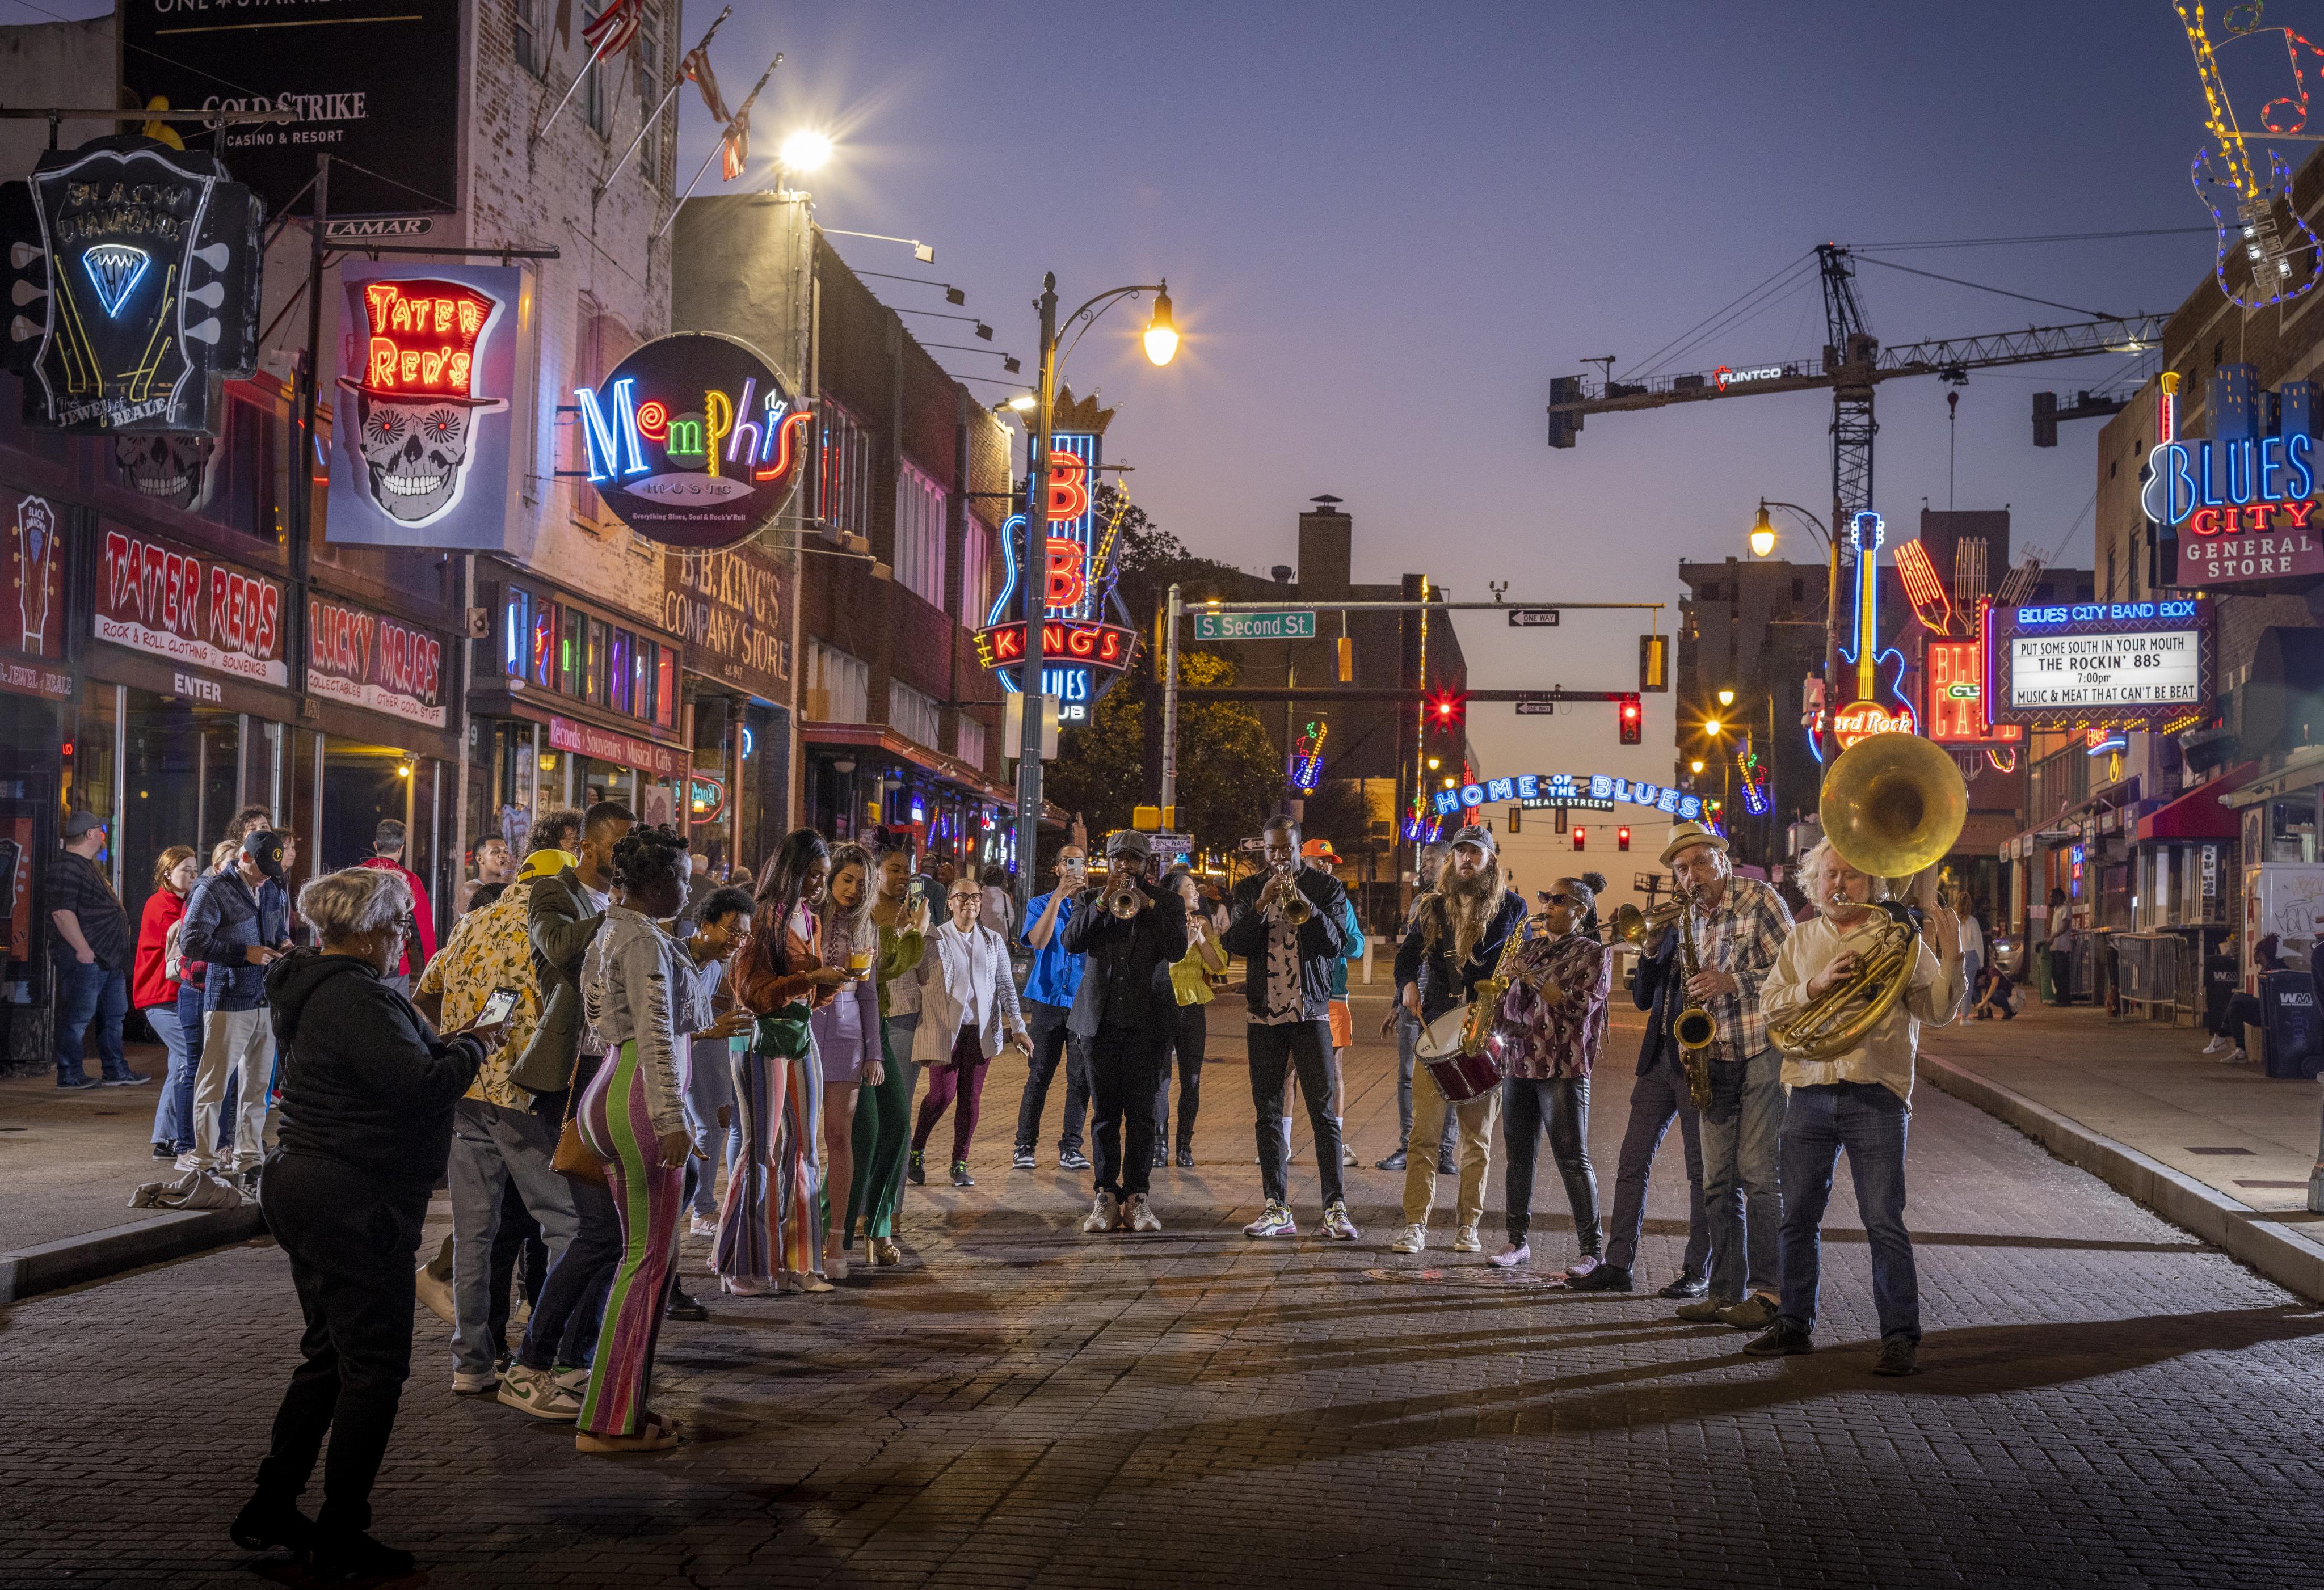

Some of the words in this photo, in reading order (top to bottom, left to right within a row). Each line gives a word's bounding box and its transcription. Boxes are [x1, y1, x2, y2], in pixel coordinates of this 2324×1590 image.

[202, 95, 271, 129] GOLD
[277, 91, 367, 125] STRIKE
[227, 133, 274, 146] CASINO
[279, 133, 287, 144] &
[292, 130, 344, 144] RESORT
[325, 220, 421, 236] LAMAR
[368, 285, 477, 333] TATER
[370, 337, 470, 387] RED'S
[1719, 368, 1781, 383] FLINTCO
[111, 397, 167, 427] BEALE
[574, 376, 812, 483] Memphis
[2167, 432, 2314, 525] BLUES
[26, 517, 47, 534] DIAMOND
[27, 505, 45, 521] BLACK
[633, 513, 667, 521] Everything
[668, 513, 687, 521] Blues,
[689, 513, 702, 521] Soul
[2190, 501, 2315, 536] CITY
[2187, 536, 2313, 560] GENERAL
[2208, 556, 2292, 577] STORE
[106, 530, 201, 637] TATER
[210, 565, 279, 659] RED'S
[2018, 607, 2068, 623] BLUES
[2072, 605, 2106, 621] CITY
[2111, 604, 2153, 618] BAND
[2159, 601, 2195, 617] BOX
[665, 589, 739, 658] COMPANY
[742, 622, 788, 682] STORE
[1202, 617, 1218, 636] S.
[1222, 616, 1281, 636] Second
[1285, 615, 1308, 634] St.
[103, 622, 129, 639] ROCK
[133, 628, 140, 643] &
[142, 632, 165, 650] ROLL
[168, 636, 208, 661] CLOTHING
[222, 655, 266, 678] SOUVENIRS
[311, 601, 374, 681] LUCKY
[379, 622, 440, 705] MOJOS
[993, 626, 1119, 660] KNG'S
[2021, 644, 2037, 655] PUT
[2041, 642, 2065, 655] SOME
[2069, 640, 2098, 653] SOUTH
[2102, 639, 2112, 652] IN
[2117, 638, 2146, 651] YOUR
[2150, 636, 2184, 651] MOUTH
[1935, 647, 1980, 685] BLU
[2039, 657, 2062, 671] THE
[2070, 655, 2127, 670] ROCKIN'
[2134, 654, 2161, 668] 88S
[7, 665, 39, 689] JEWEL
[45, 673, 73, 695] BEALE
[174, 674, 221, 703] ENTER
[308, 674, 361, 698] COLLECTABLES
[376, 694, 399, 708] OTHER
[401, 698, 418, 714] COOL
[420, 707, 440, 721] STUFF
[2018, 690, 2047, 703] MUSIC
[2051, 689, 2058, 702] &
[2062, 689, 2087, 702] MEAT
[2092, 687, 2117, 701] THAT
[2121, 686, 2150, 700] CAN'T
[2155, 685, 2166, 699] BE
[2170, 685, 2195, 698] BEAT
[1058, 705, 1085, 719] UB
[1866, 710, 1913, 735] Rock
[550, 719, 582, 749] Records
[586, 729, 622, 762] Souvenirs
[626, 743, 652, 768] Musical
[655, 751, 671, 773] Gifts
[1548, 786, 1577, 797] THE
[1552, 774, 1573, 786] OF
[1434, 774, 1539, 815] HOME
[1529, 799, 1564, 808] BEALE
[1567, 799, 1607, 809] STREET
[1590, 774, 1702, 820] BLUES
[2213, 971, 2238, 980] WM
[2280, 993, 2314, 1003] WM
